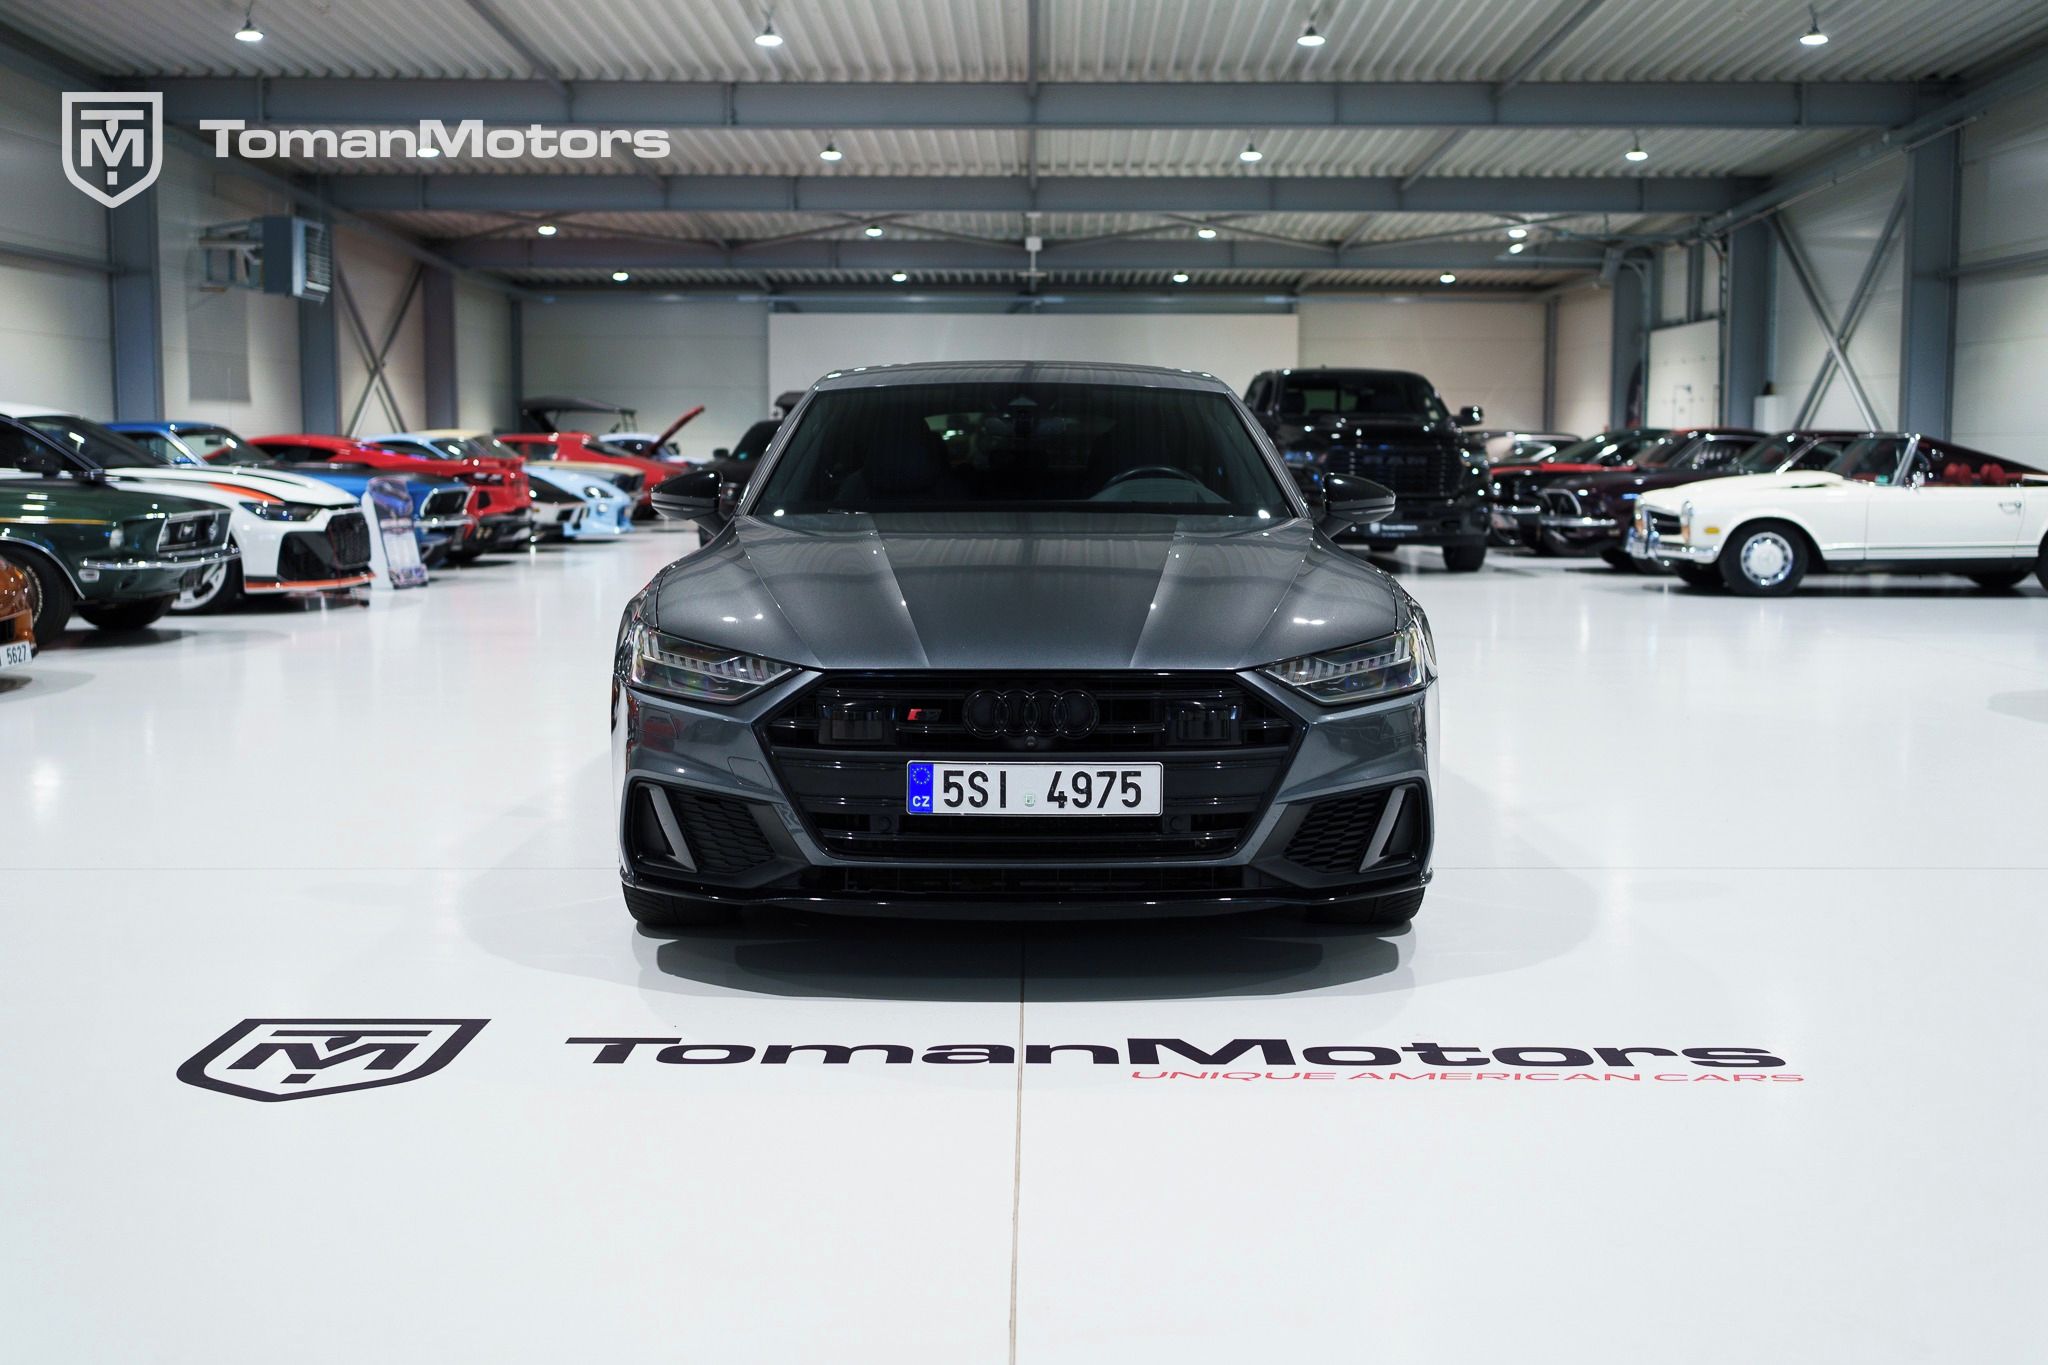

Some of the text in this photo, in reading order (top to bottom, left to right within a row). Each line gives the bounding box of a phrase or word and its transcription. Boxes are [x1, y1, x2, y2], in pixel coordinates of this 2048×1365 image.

[7, 644, 27, 665] 5627
[912, 770, 1142, 808] CZ 5SI 4975
[566, 1037, 1786, 1068] TomanMotors
[1132, 1071, 1804, 1082] UNIQUE AMERICAN CARS
